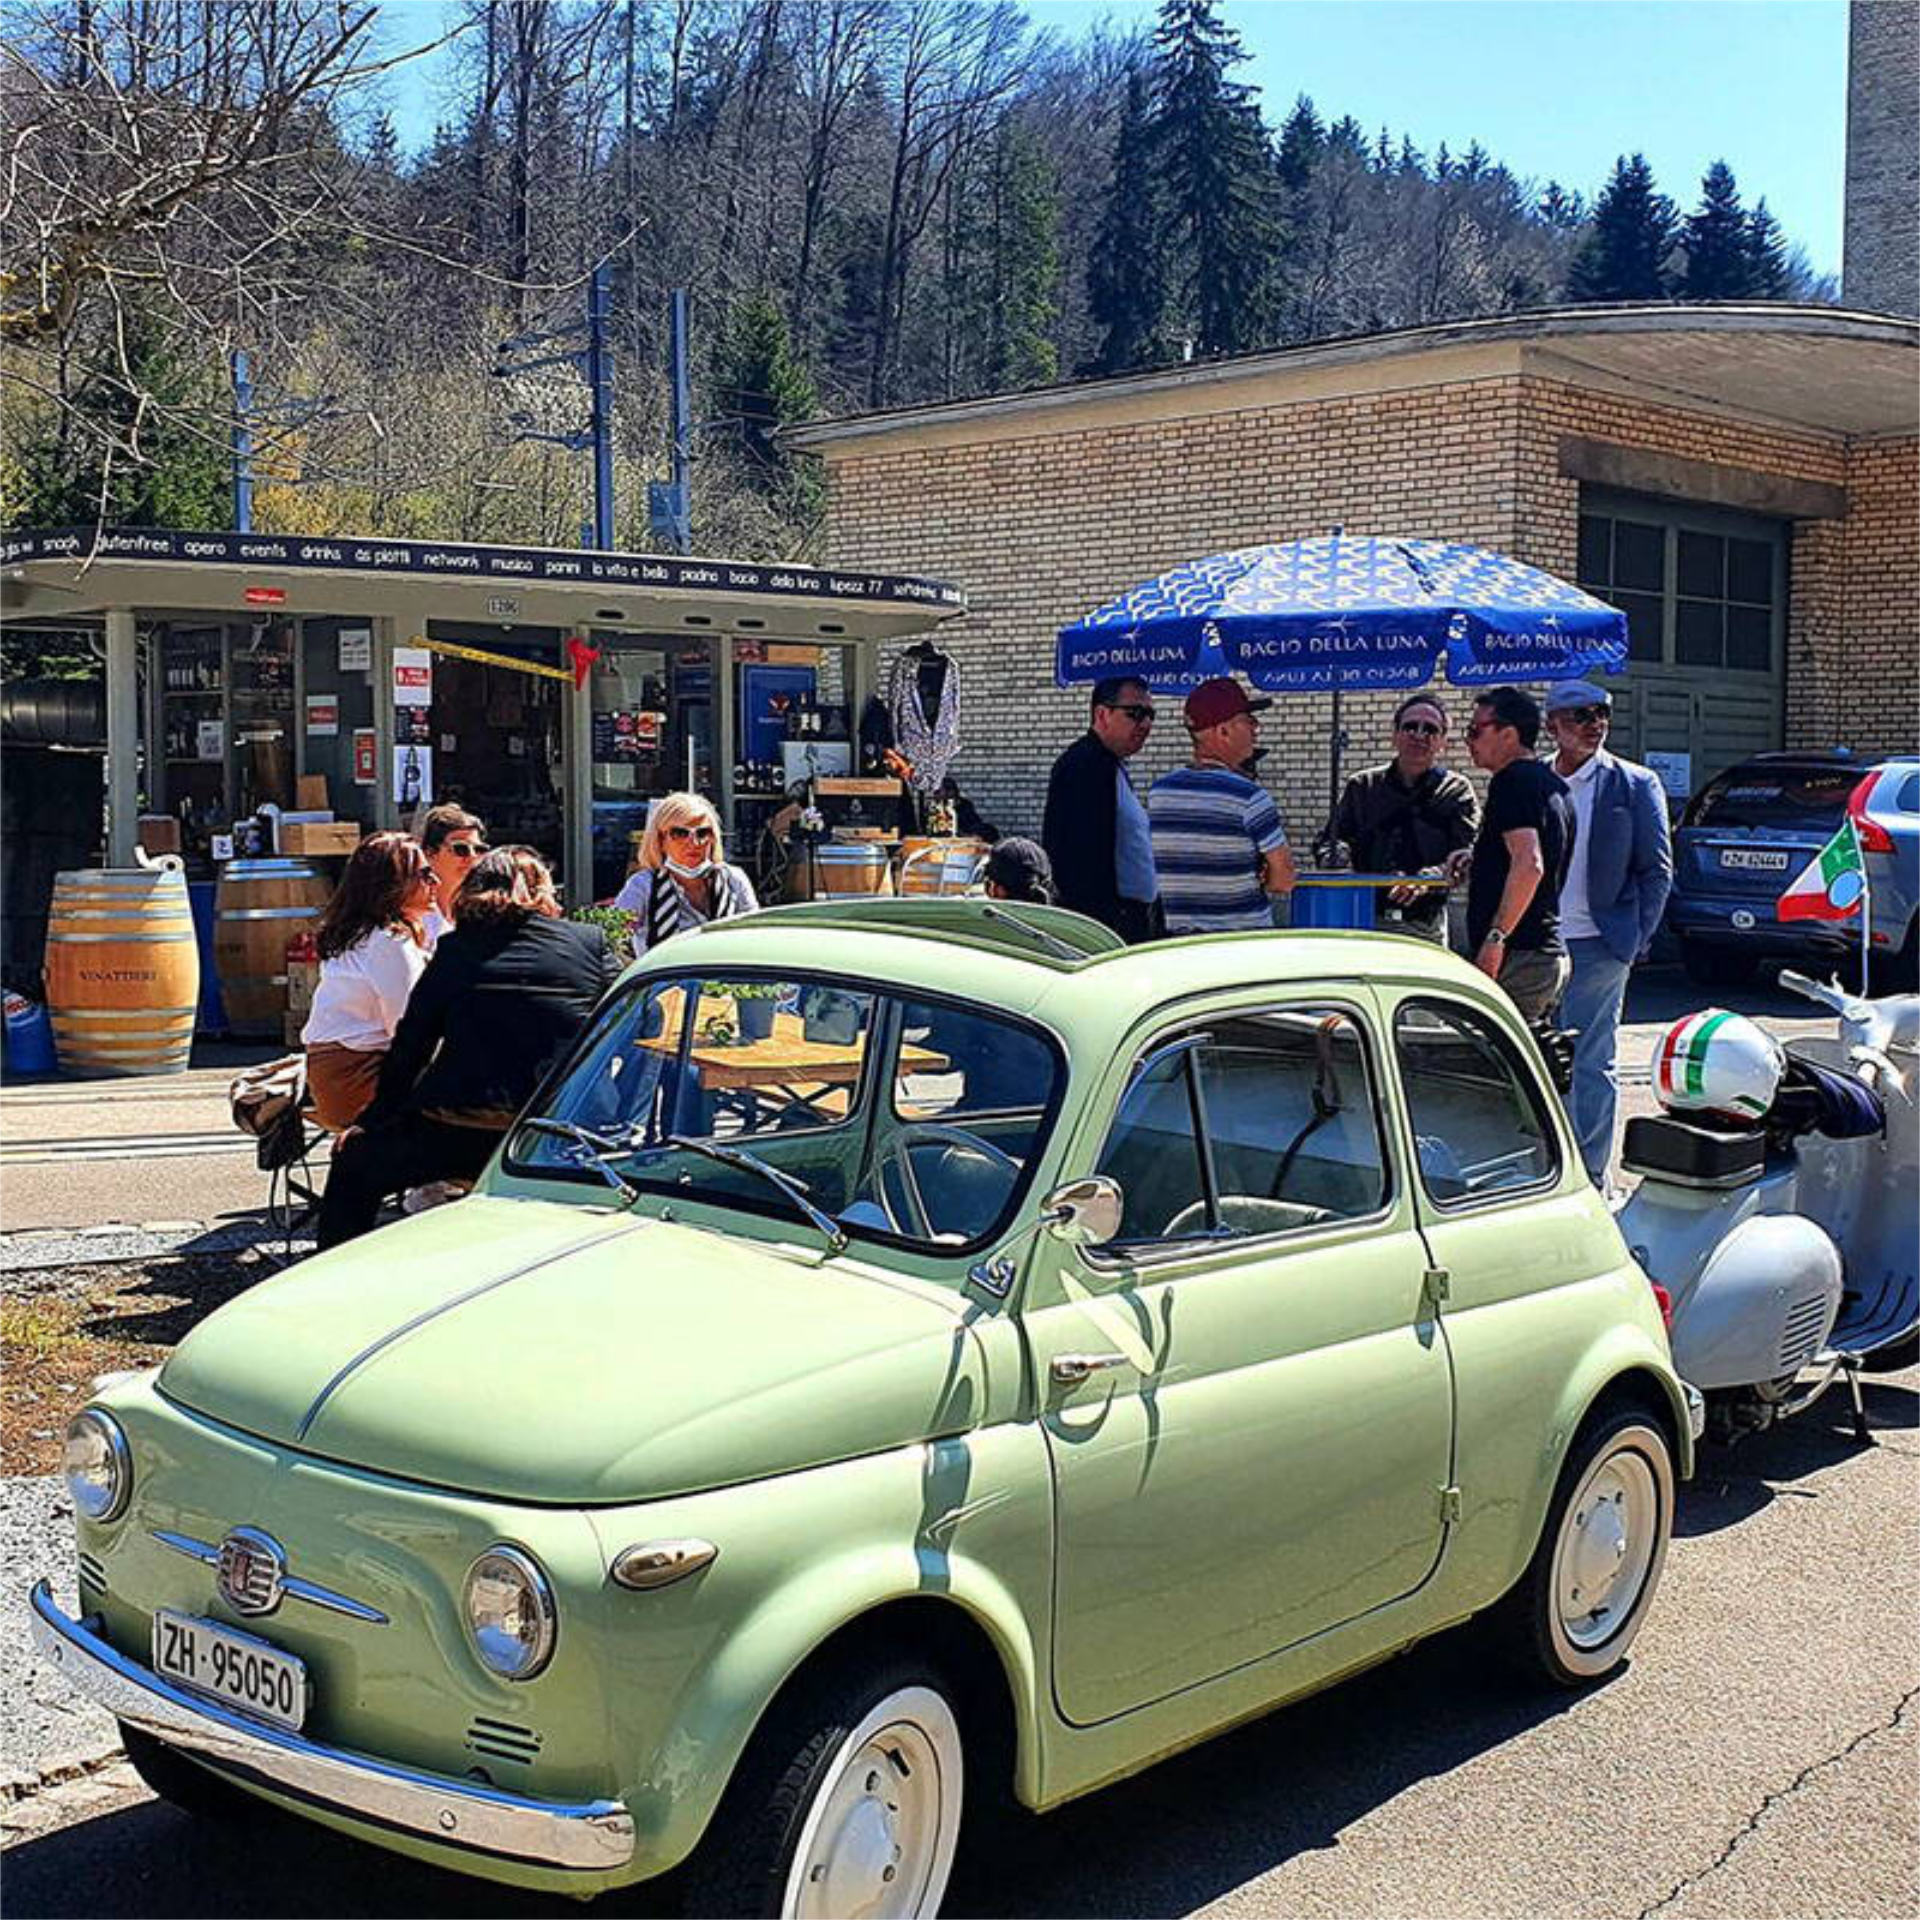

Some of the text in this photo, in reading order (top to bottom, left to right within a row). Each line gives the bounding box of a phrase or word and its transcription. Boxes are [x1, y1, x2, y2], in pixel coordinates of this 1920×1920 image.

[184, 541, 226, 556] opera
[240, 544, 287, 558] events
[301, 545, 341, 561] drinks
[424, 553, 480, 570] network
[491, 558, 534, 572] musica
[546, 561, 580, 575] panini
[643, 565, 668, 580] bella
[729, 570, 759, 585] bacio
[770, 574, 795, 589] della
[797, 575, 821, 590] luna
[868, 580, 883, 594] 77
[1239, 635, 1429, 657] BACIO DELLA LUNA
[1485, 633, 1532, 649] BACIO
